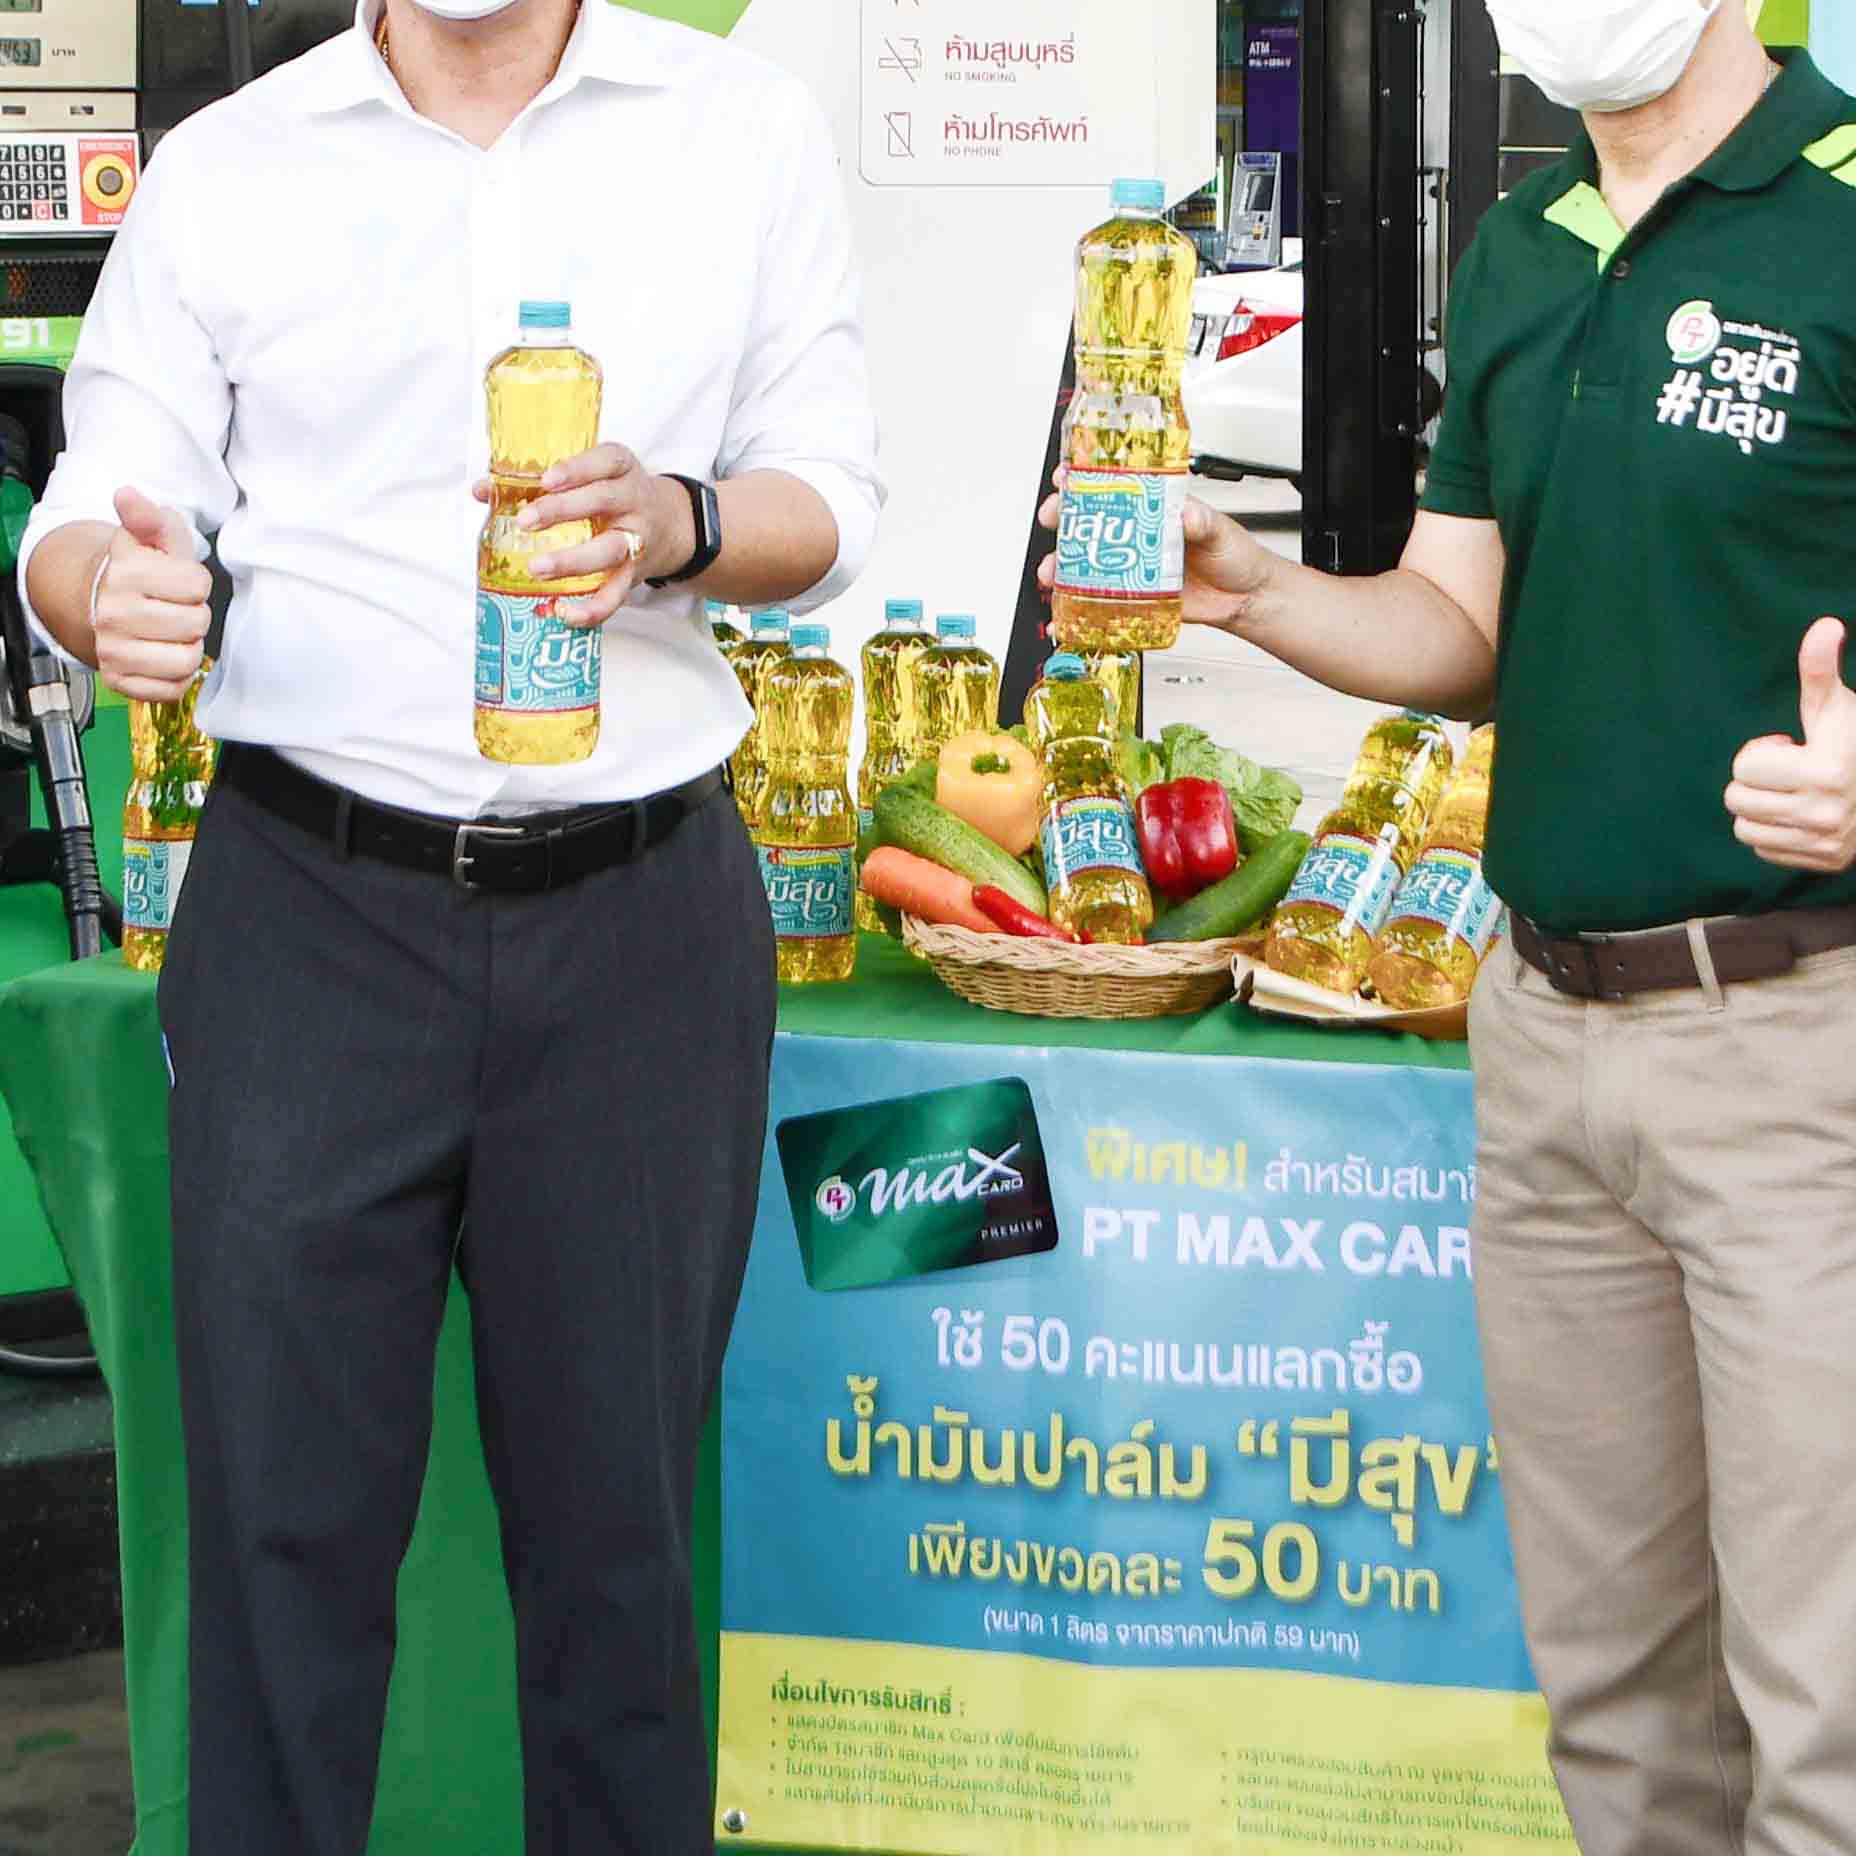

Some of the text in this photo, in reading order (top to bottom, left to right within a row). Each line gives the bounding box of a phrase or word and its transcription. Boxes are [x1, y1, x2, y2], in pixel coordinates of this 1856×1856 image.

[944, 31, 1076, 70] ห้ามสูบบุหรี่
[943, 110, 1089, 144] ห้ามโทรศัพท์
[1710, 341, 1801, 401] อยู่ดี
[1655, 369, 1787, 455] #มีสุข
[766, 874, 838, 922] มีสุข
[976, 1177, 1023, 1196] CARD
[1084, 1126, 1249, 1193] พิเศษ!
[979, 1218, 1044, 1241] PREMIER
[1081, 1206, 1476, 1280] PT MAX CAR
[930, 1305, 1425, 1394] ใช้ 50 คะแนนแลกซื้อ
[824, 1372, 1209, 1500] น้ำมันปาล์ม
[906, 1516, 1442, 1614] เพียงขวดละ 50 บาท
[770, 1669, 953, 1717] เงื่อนไขการรับสิทธิ์
